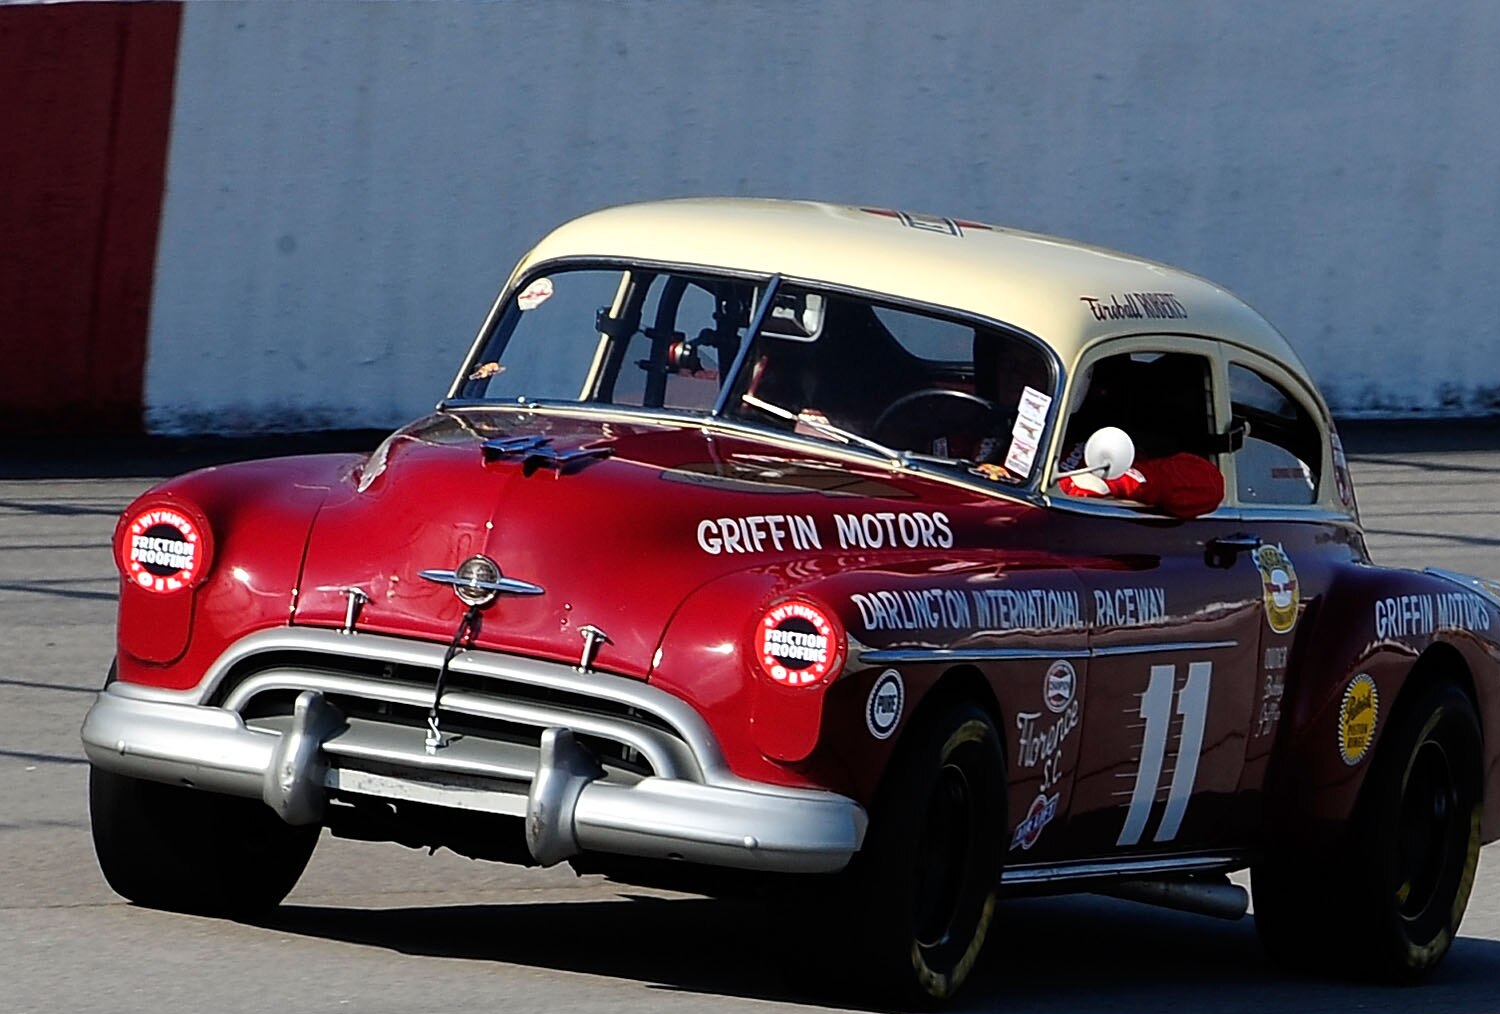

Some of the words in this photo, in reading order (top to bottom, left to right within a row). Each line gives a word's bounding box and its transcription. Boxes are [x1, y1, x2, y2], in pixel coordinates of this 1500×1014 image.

[1080, 294, 1142, 321] Fireball
[138, 511, 191, 534] WYNN'S
[697, 514, 822, 554] GRIFFIN
[834, 511, 953, 549] MOTORS
[131, 535, 195, 556] FRICTION
[130, 548, 194, 570] PROOFING
[137, 571, 183, 591] OIL
[771, 604, 824, 627] WYNN'S
[851, 588, 972, 630] DARLINGTON
[972, 589, 1084, 629] INTERNATIONAL
[1094, 587, 1166, 627] RACEWAY
[1375, 594, 1433, 639] GRIFFIN
[1437, 592, 1491, 634] MOTORS
[764, 628, 827, 649] FRICTION
[763, 641, 827, 663] PROOFING
[770, 665, 816, 684] OIL
[1016, 699, 1079, 767] Florence
[1114, 660, 1213, 846] 11
